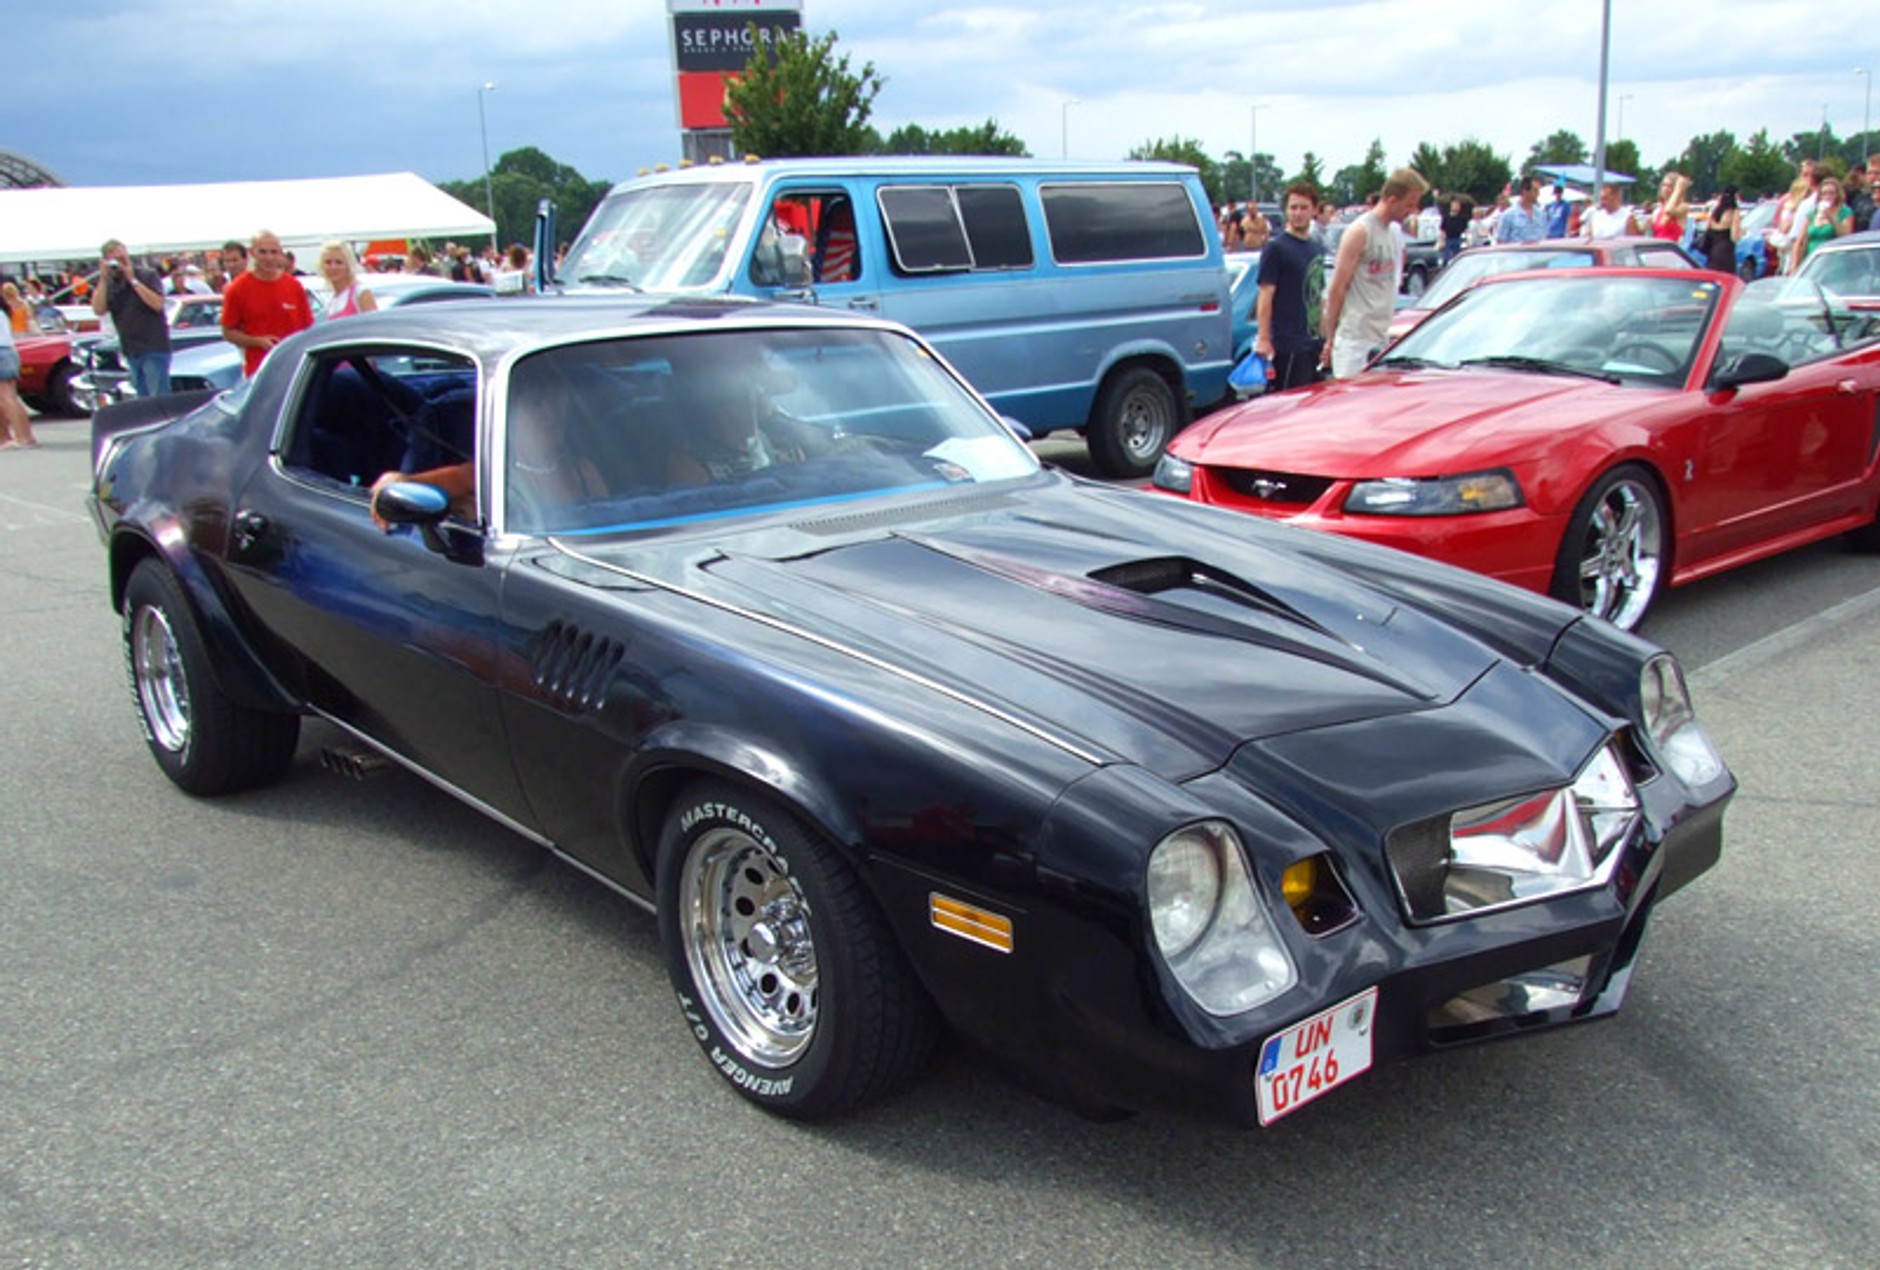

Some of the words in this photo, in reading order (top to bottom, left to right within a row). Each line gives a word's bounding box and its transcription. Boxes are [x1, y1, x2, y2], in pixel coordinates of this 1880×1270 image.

[1295, 1015, 1333, 1059] UN
[711, 1046, 793, 1096] AVENGER
[1272, 1048, 1338, 1111] 0746
